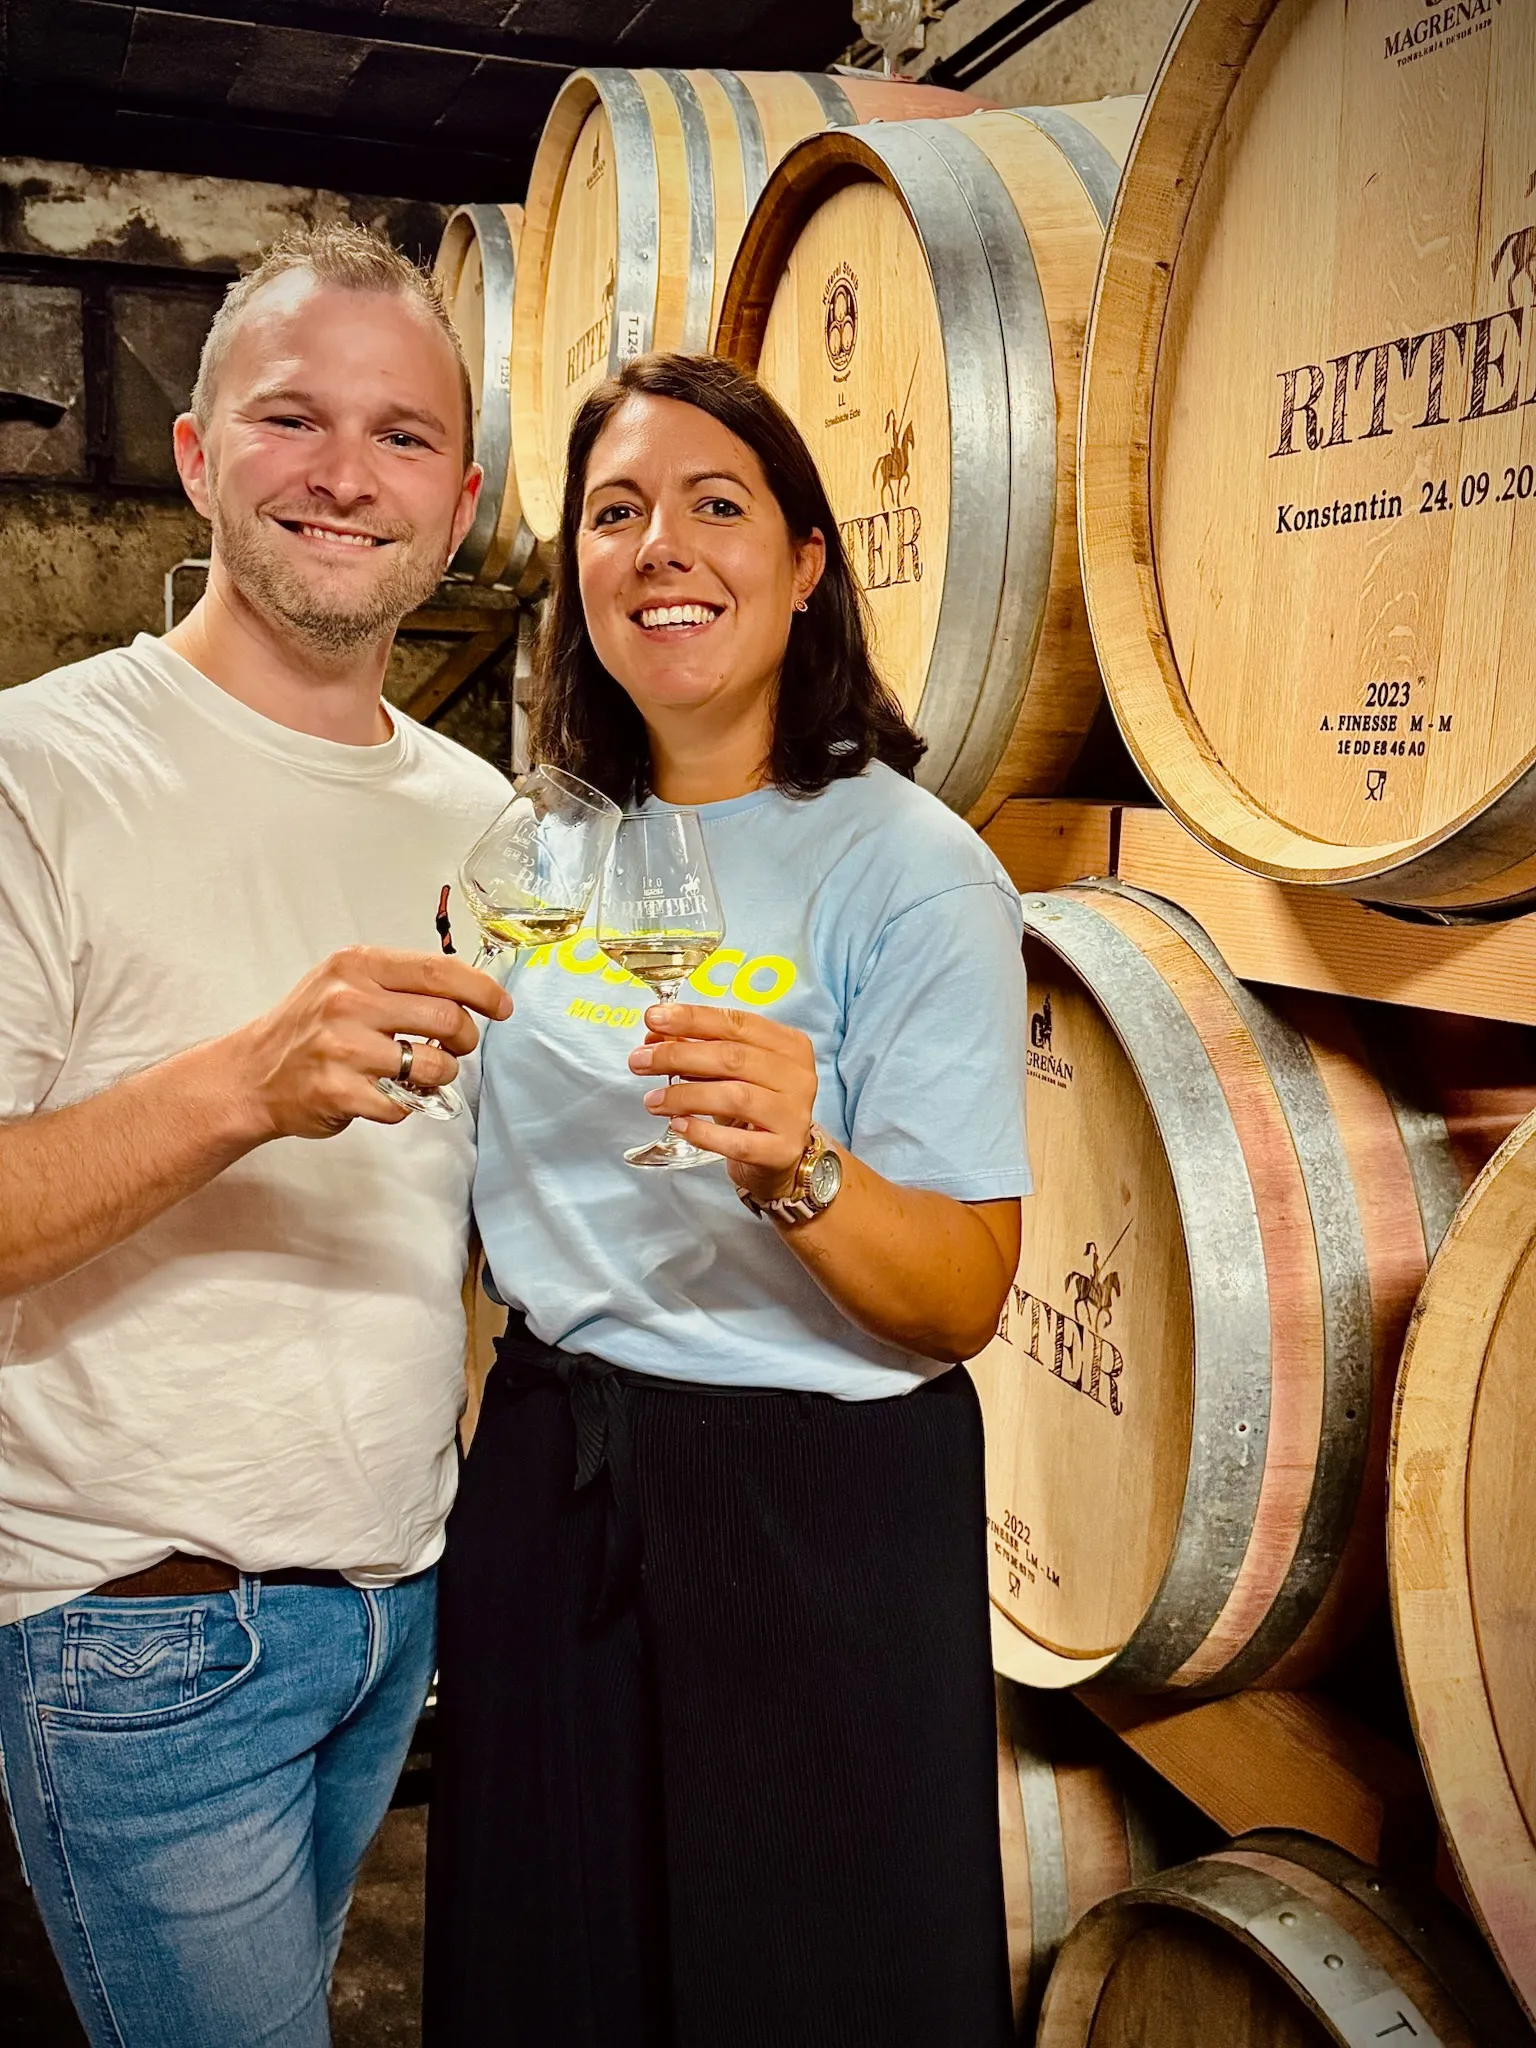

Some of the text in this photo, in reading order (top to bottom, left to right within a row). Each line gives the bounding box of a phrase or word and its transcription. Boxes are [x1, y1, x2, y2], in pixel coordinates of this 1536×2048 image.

[1268, 305, 1536, 459] RITTE
[1276, 464, 1536, 534] Konstantin 24.09.20
[1365, 682, 1411, 707] 2023
[1337, 715, 1398, 732] FINESSE
[564, 998, 642, 1029] MOOD
[1003, 1508, 1031, 1546] 2022
[1375, 2010, 1418, 2038] T
